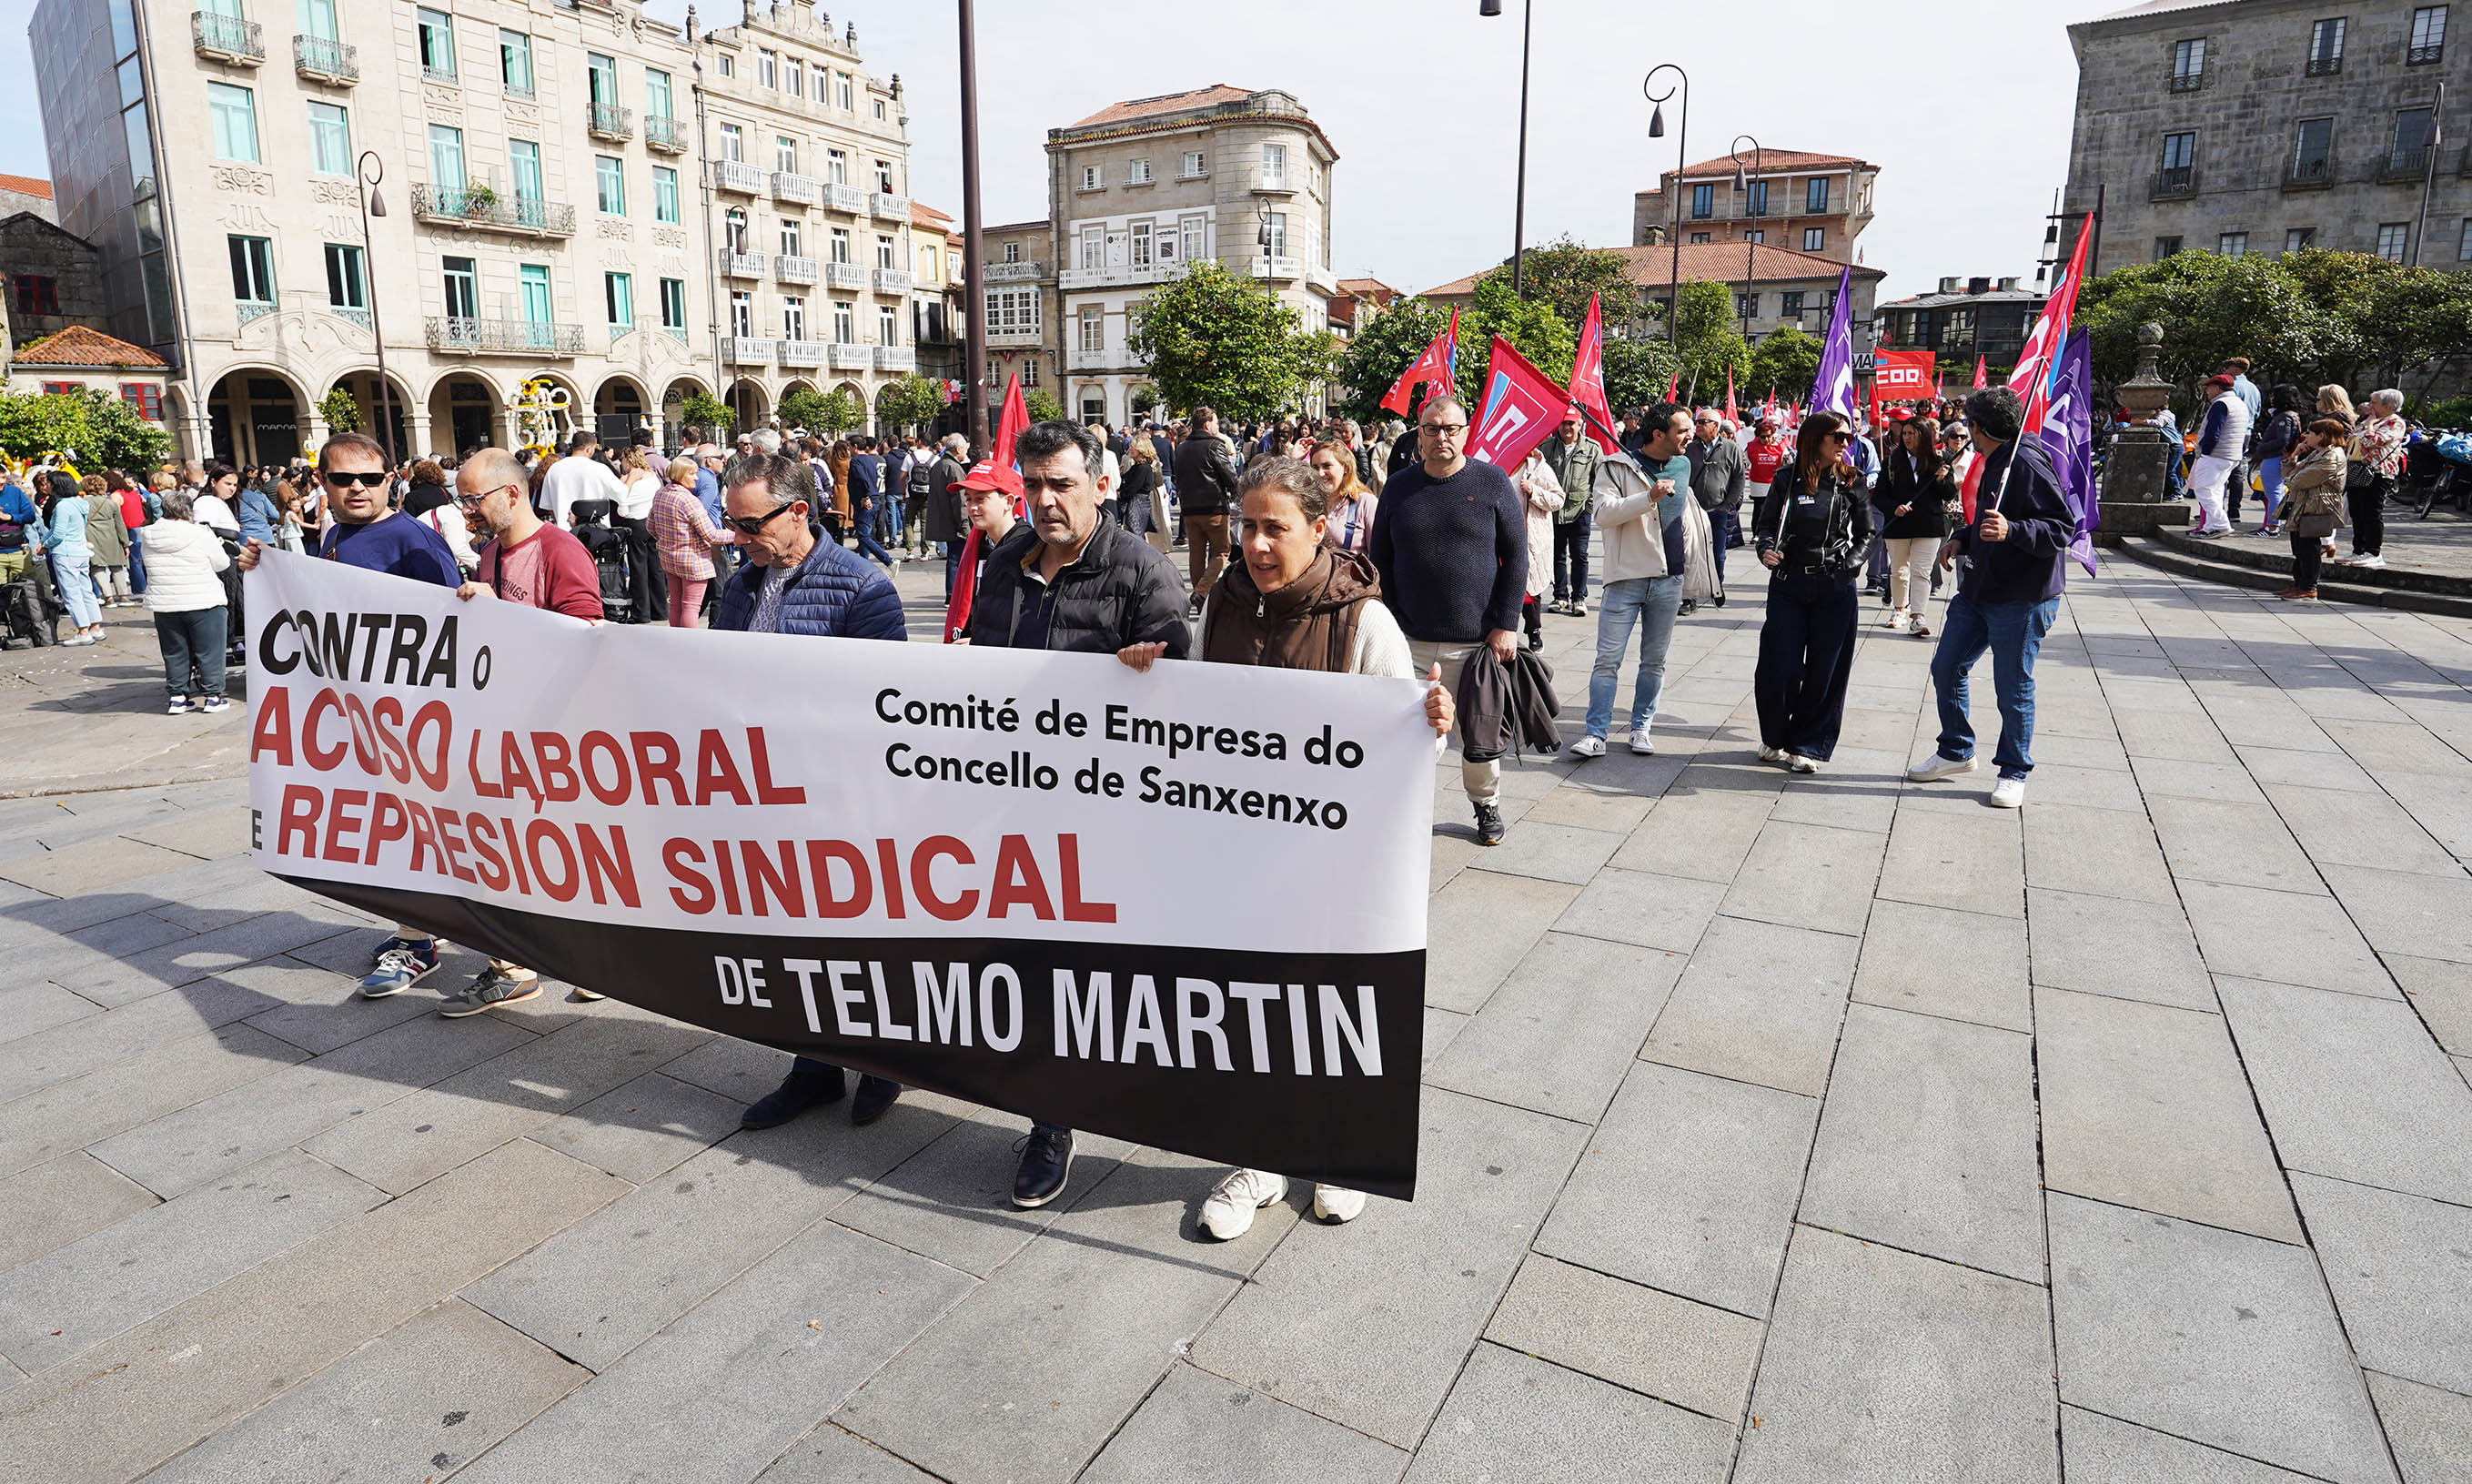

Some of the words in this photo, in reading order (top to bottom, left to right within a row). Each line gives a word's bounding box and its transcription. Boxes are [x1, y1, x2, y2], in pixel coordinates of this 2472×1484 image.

[258, 608, 459, 689] CONTRA
[250, 686, 453, 792] ACOSO
[469, 727, 807, 806] LABORAL
[875, 688, 1020, 732] Comité
[1034, 698, 1088, 738] de
[1105, 703, 1286, 761] Empresa
[1303, 724, 1364, 769] do
[885, 742, 1059, 791] Concello
[1074, 757, 1125, 798] de
[1138, 765, 1347, 831] Sanxenxo
[277, 783, 641, 908] REPRESIÓN
[661, 833, 1116, 924] SINDICAL
[714, 955, 772, 1010] DE
[782, 957, 1024, 1053] TELMO
[1053, 968, 1384, 1077] MARTIN
